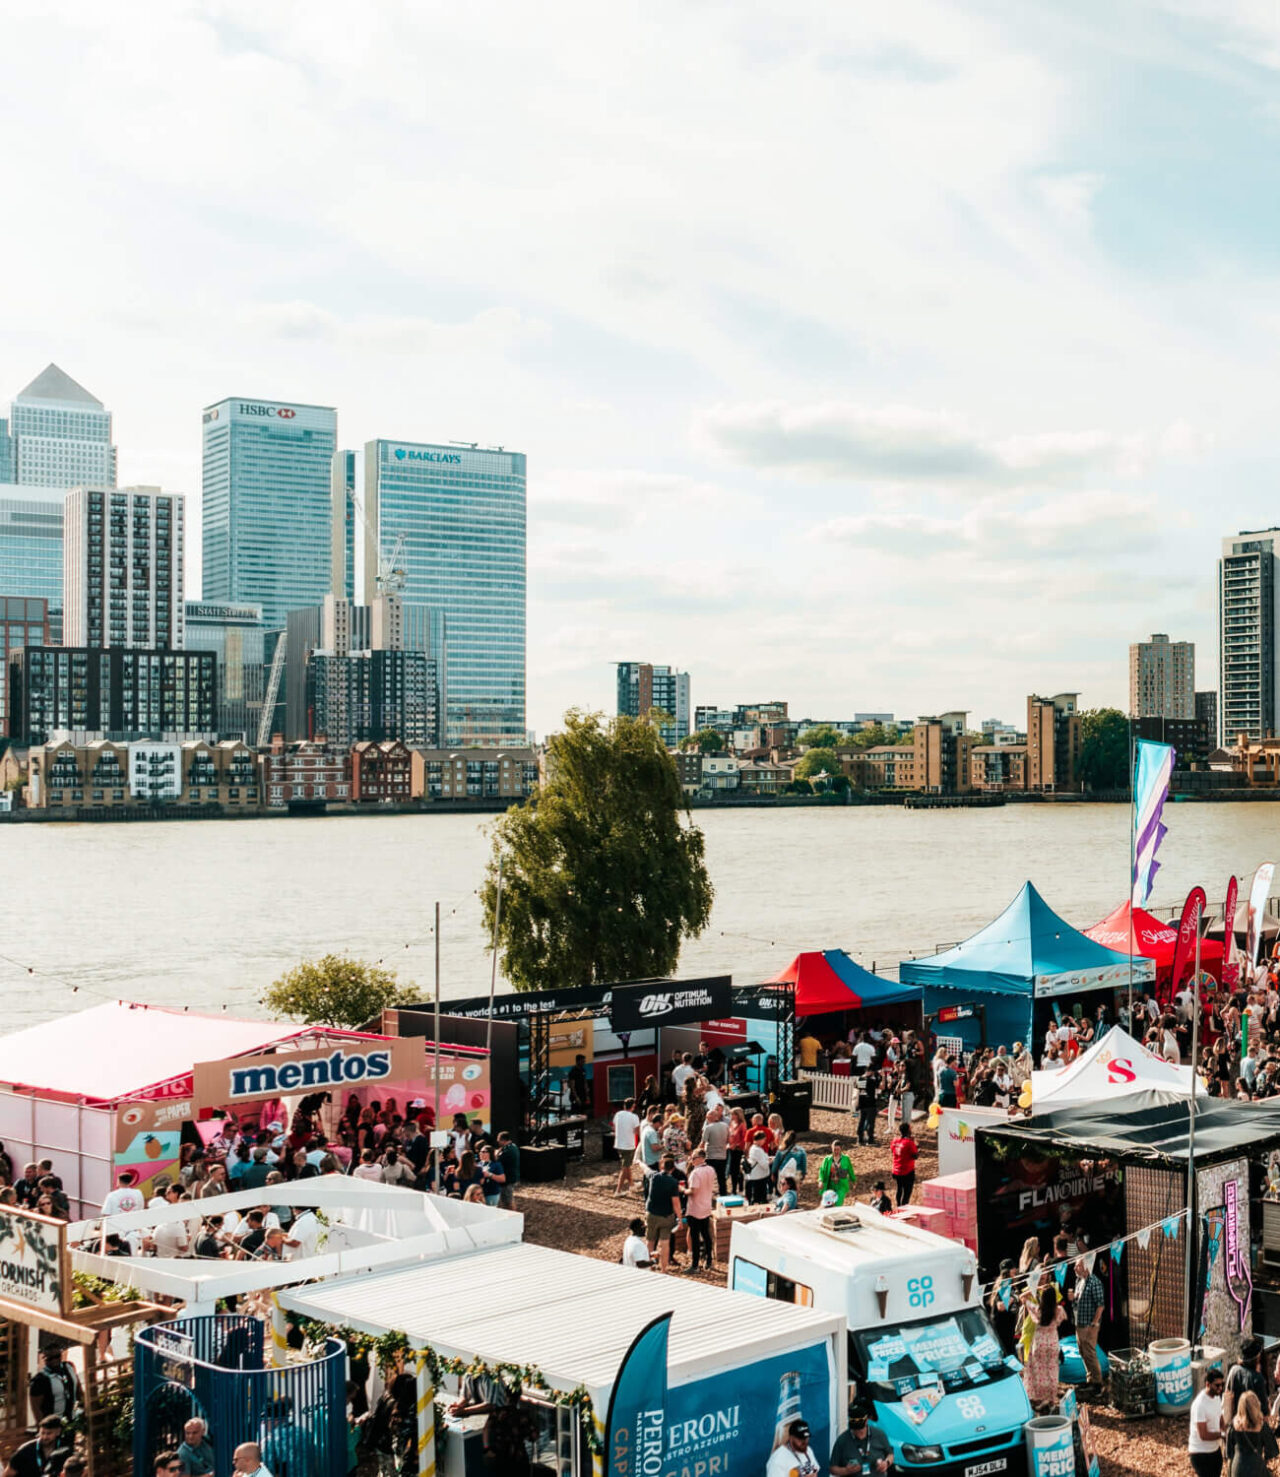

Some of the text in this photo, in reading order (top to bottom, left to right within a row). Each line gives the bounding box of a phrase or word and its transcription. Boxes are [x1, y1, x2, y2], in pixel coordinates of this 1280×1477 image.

[239, 403, 276, 418] HSBC
[408, 450, 461, 464] BARCLAYS
[500, 1004, 510, 1013] #1
[512, 1004, 522, 1012] to
[523, 1002, 538, 1011] the
[540, 1000, 556, 1010] test
[639, 994, 672, 1014] ON
[674, 989, 708, 1000] OPTIMUM
[674, 996, 712, 1009] NUTRITION
[231, 1050, 391, 1097] mentos
[0, 1260, 45, 1293] ORNISH
[668, 1405, 740, 1449] ERONI
[614, 1427, 629, 1477] CAP
[643, 1409, 664, 1477] PERO
[664, 1429, 739, 1462] STRO AZZURRO
